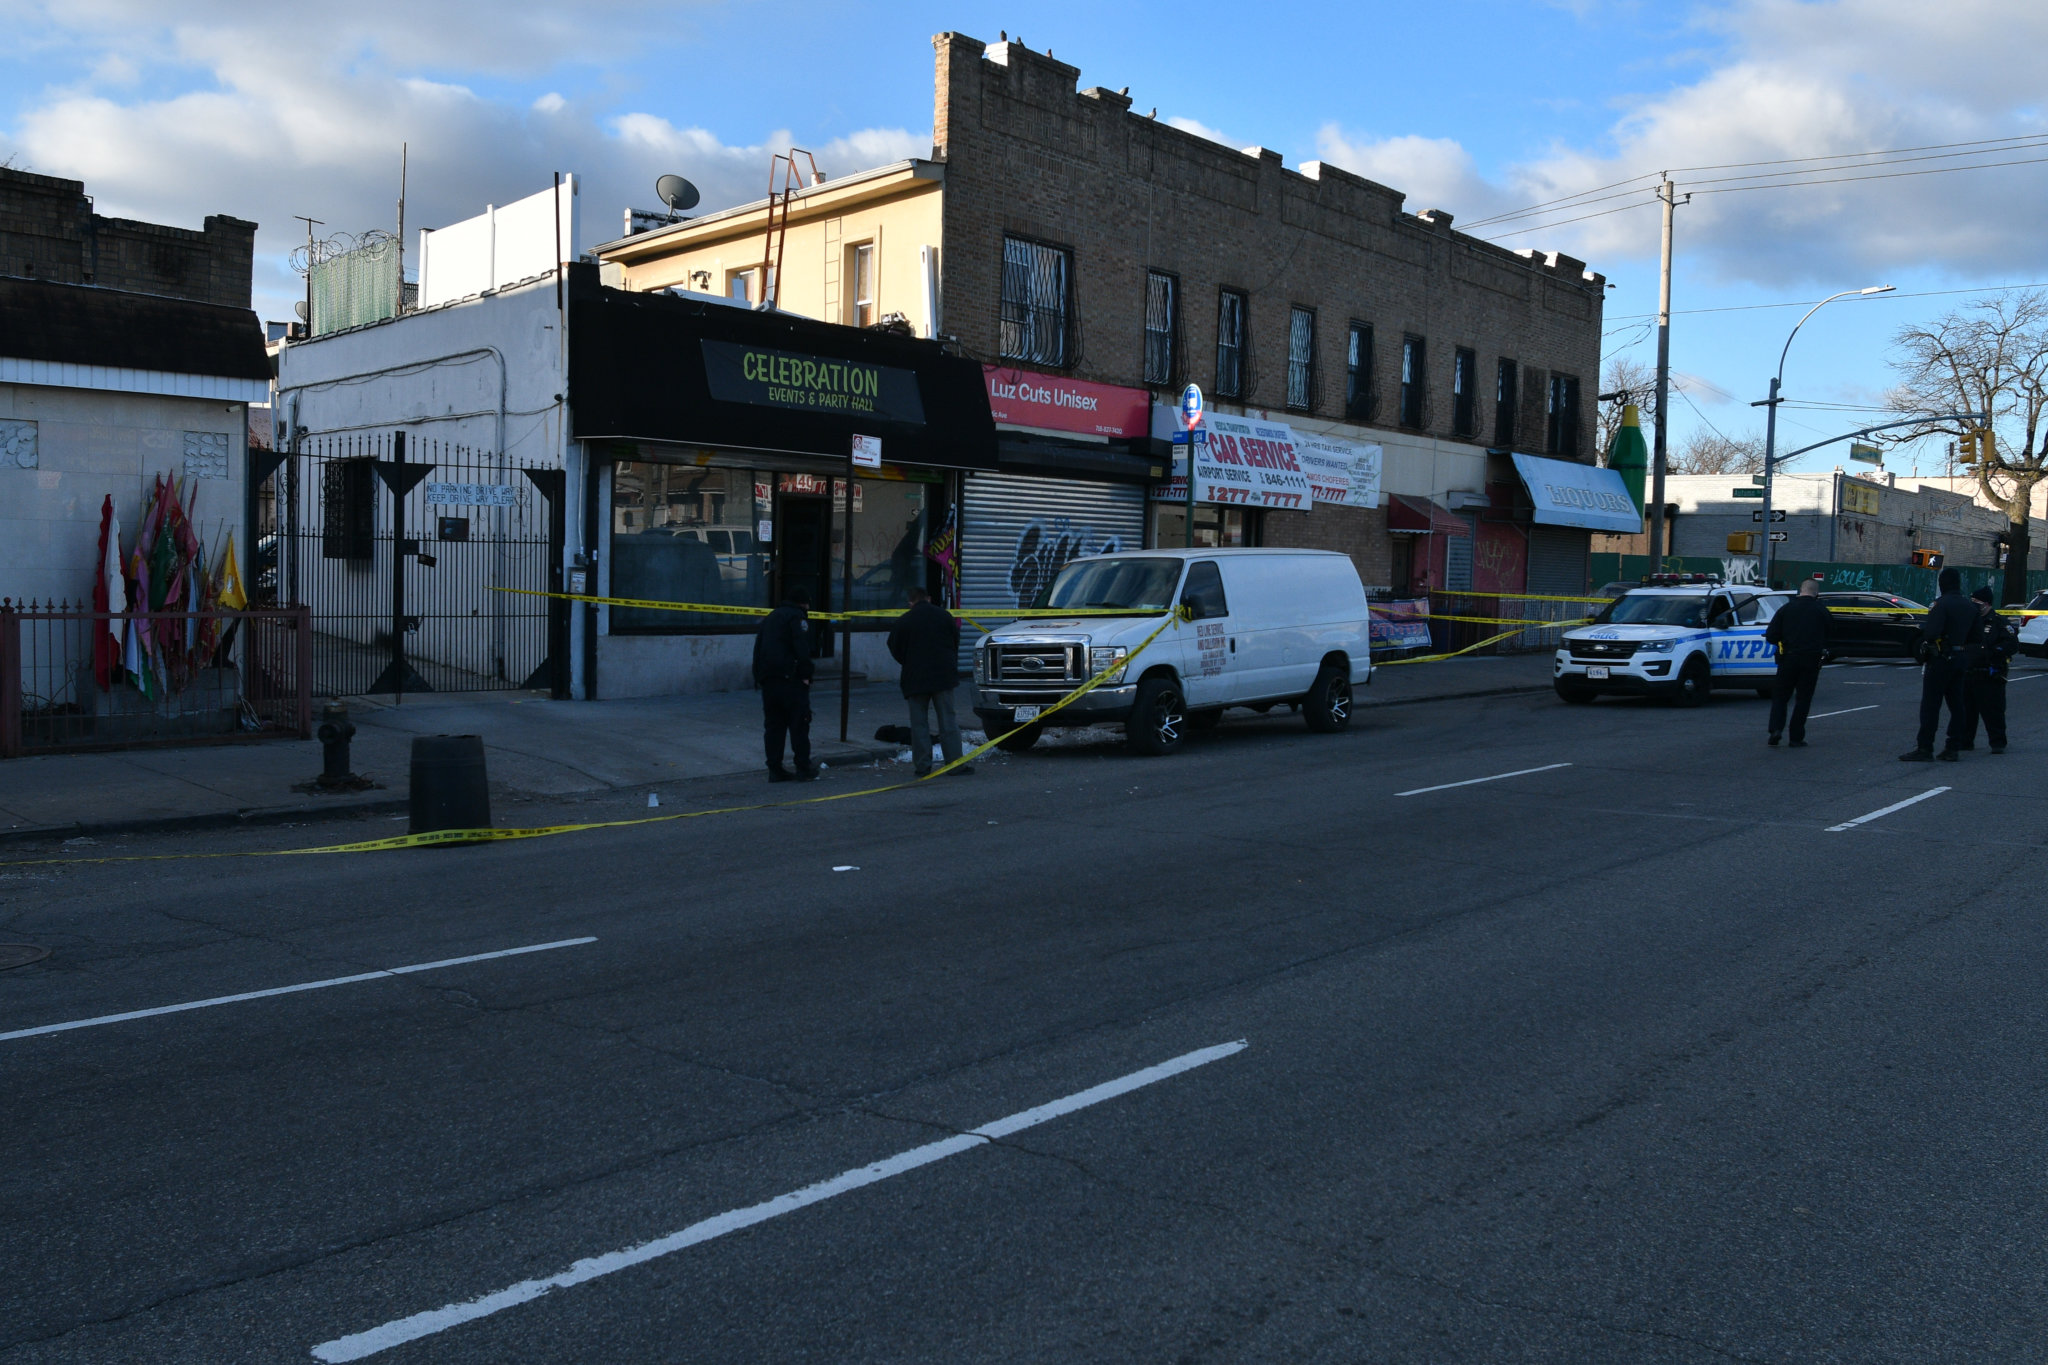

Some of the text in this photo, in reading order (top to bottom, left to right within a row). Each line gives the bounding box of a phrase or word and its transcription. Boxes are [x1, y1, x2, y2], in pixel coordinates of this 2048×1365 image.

[744, 352, 878, 398] CELEBRATION
[769, 387, 874, 412] EVENTS & PARTY HALL
[991, 378, 1098, 411] Luz Cuts Unisex
[1208, 432, 1301, 472] CAR SERVICE
[1301, 456, 1325, 467] DRIVERS
[1326, 460, 1348, 470] WANTED
[1198, 466, 1224, 480] AIRPORT
[1224, 468, 1252, 483] SERVICE
[1265, 474, 1307, 489] 846-1111
[426, 484, 514, 496] NO PARKING DRIVE WAY
[427, 494, 446, 502] KEEP
[450, 494, 472, 503] DRIVE
[476, 495, 489, 503] WAY
[1157, 488, 1188, 498] 277-777
[1216, 486, 1250, 503] 277
[1261, 491, 1302, 508] 7777
[1311, 484, 1347, 502] 77-7777
[1545, 484, 1632, 513] LIQUORS
[1588, 632, 1620, 640] POLICE
[1718, 640, 1778, 659] NYPD
